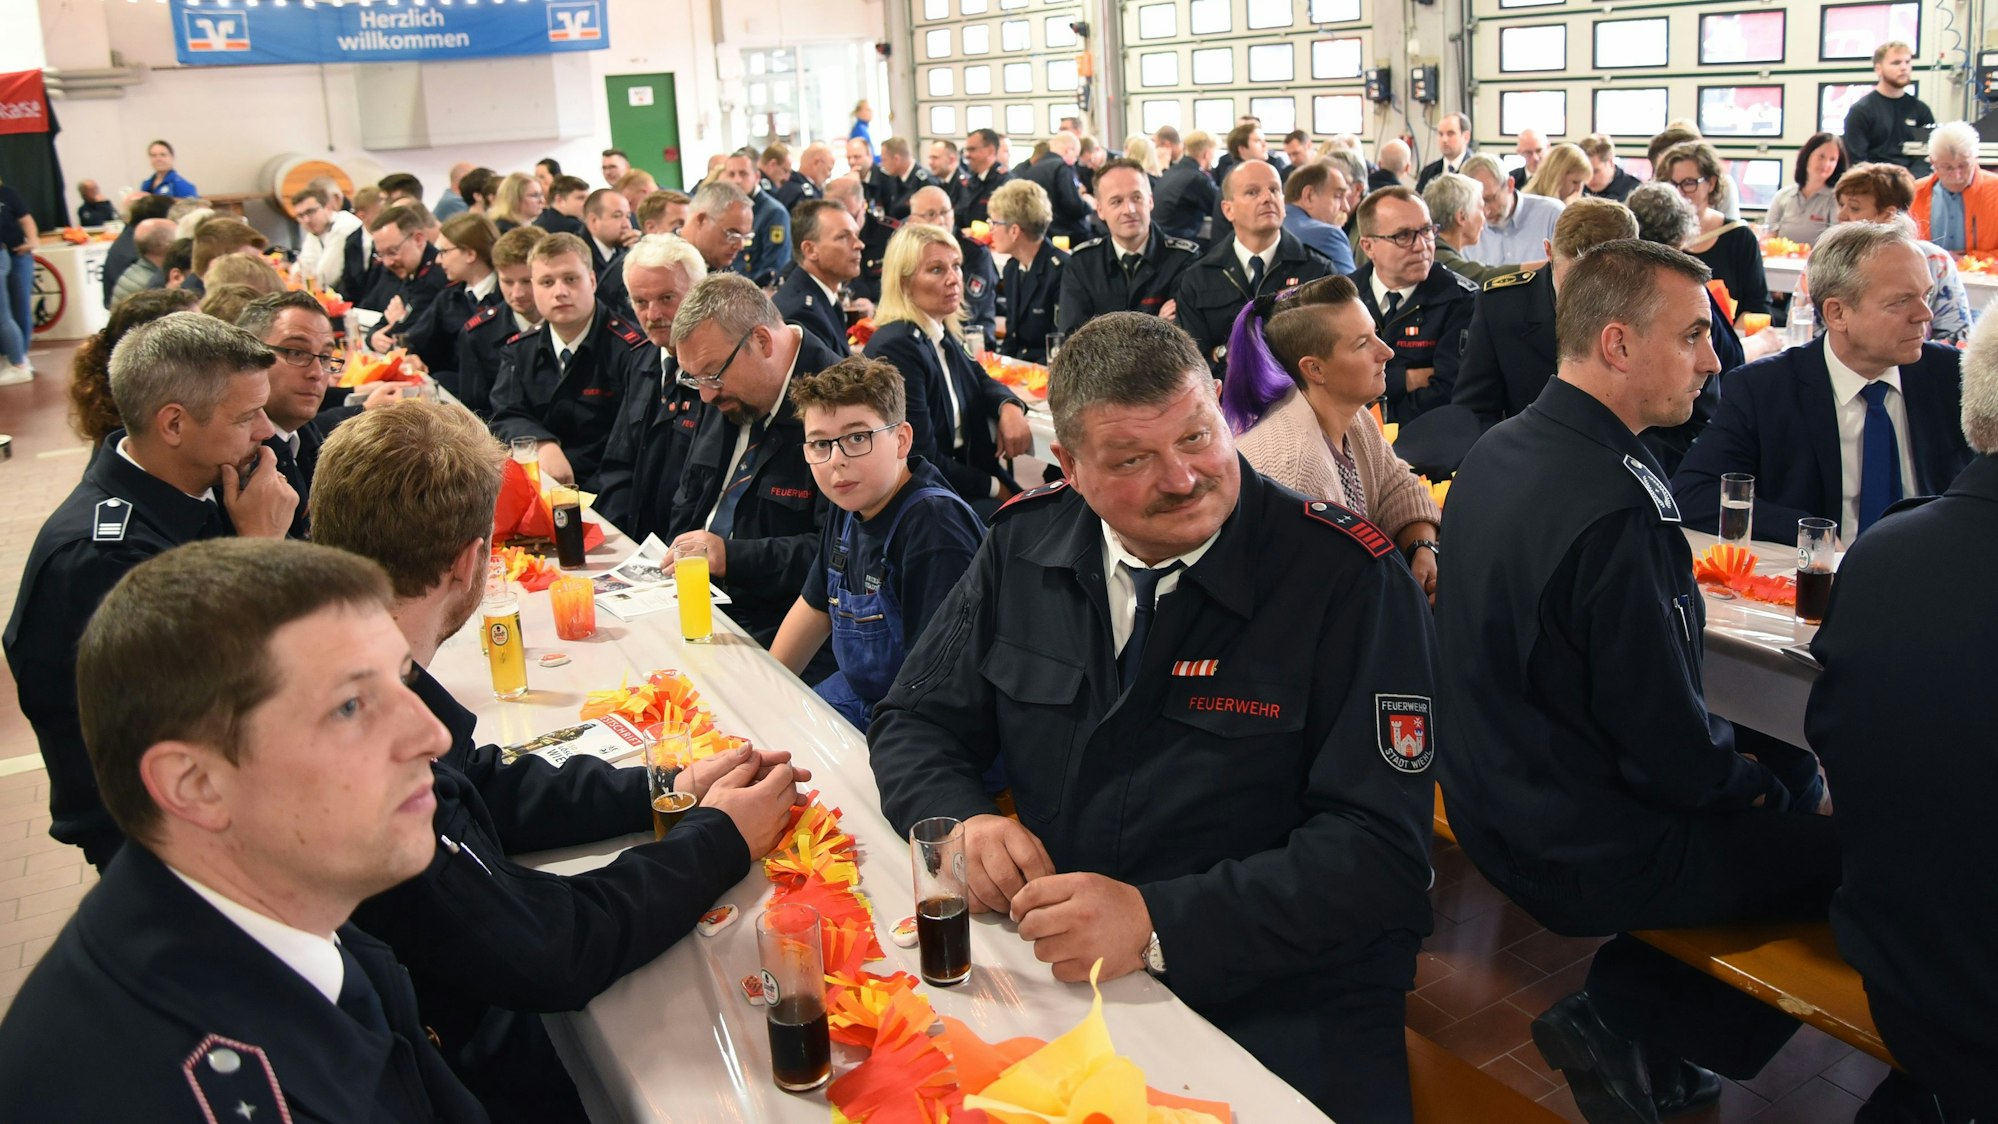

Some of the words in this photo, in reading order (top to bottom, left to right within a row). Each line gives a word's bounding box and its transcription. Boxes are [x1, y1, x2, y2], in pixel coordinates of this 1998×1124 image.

[360, 8, 445, 29] Herzlich
[337, 30, 470, 50] willkommen
[1189, 697, 1281, 719] FEUERWEHR
[1381, 700, 1428, 713] FEUERWEHR
[601, 716, 642, 745] ESTSCHRIFT
[1385, 747, 1409, 768] STADT
[1411, 750, 1432, 769] WIEHL
